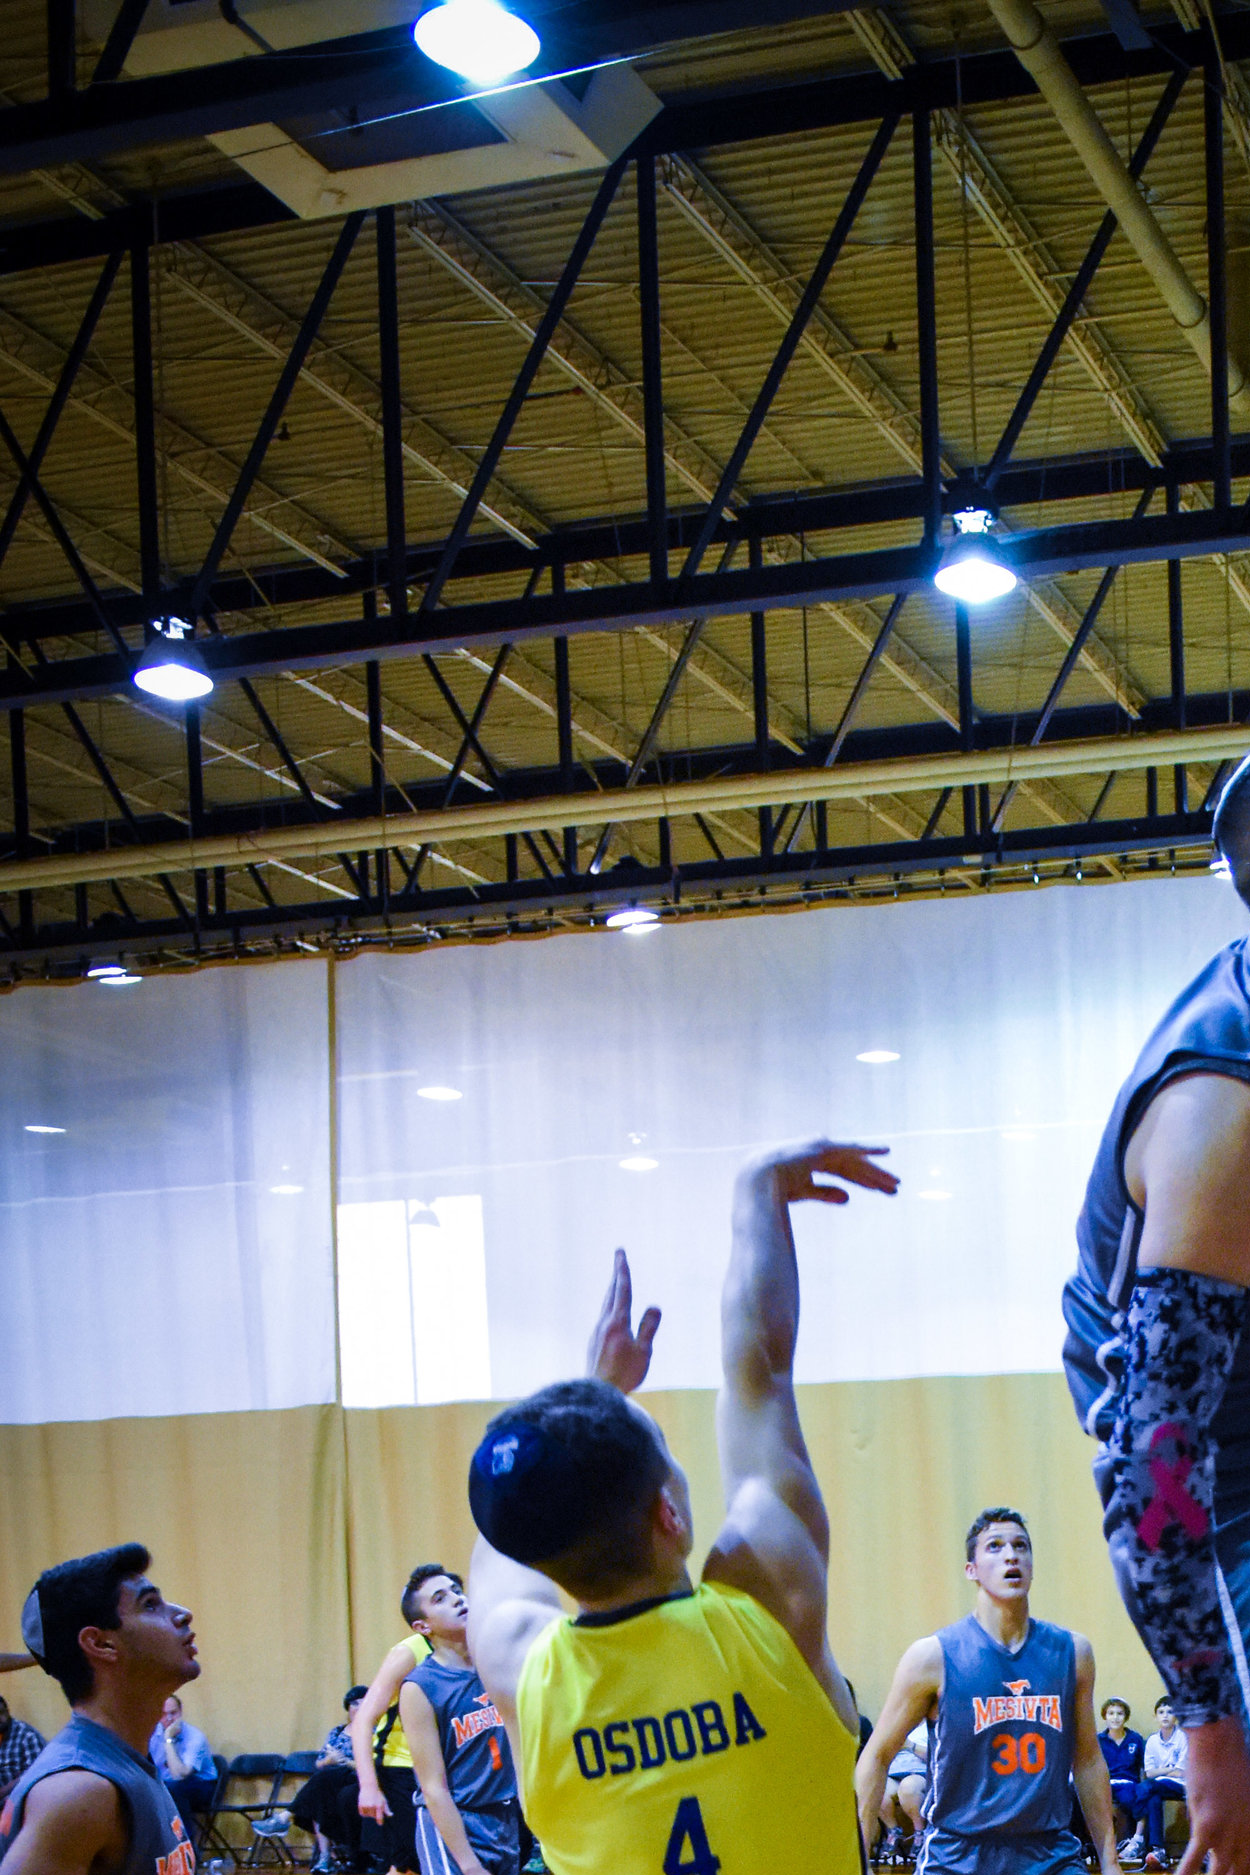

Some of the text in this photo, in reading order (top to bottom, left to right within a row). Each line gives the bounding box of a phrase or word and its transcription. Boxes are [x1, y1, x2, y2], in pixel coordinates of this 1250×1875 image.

[572, 1691, 768, 1781] OSDOBA
[972, 1694, 1063, 1736] MESIVTA
[487, 1735, 504, 1772] 1
[991, 1732, 1047, 1776] 30
